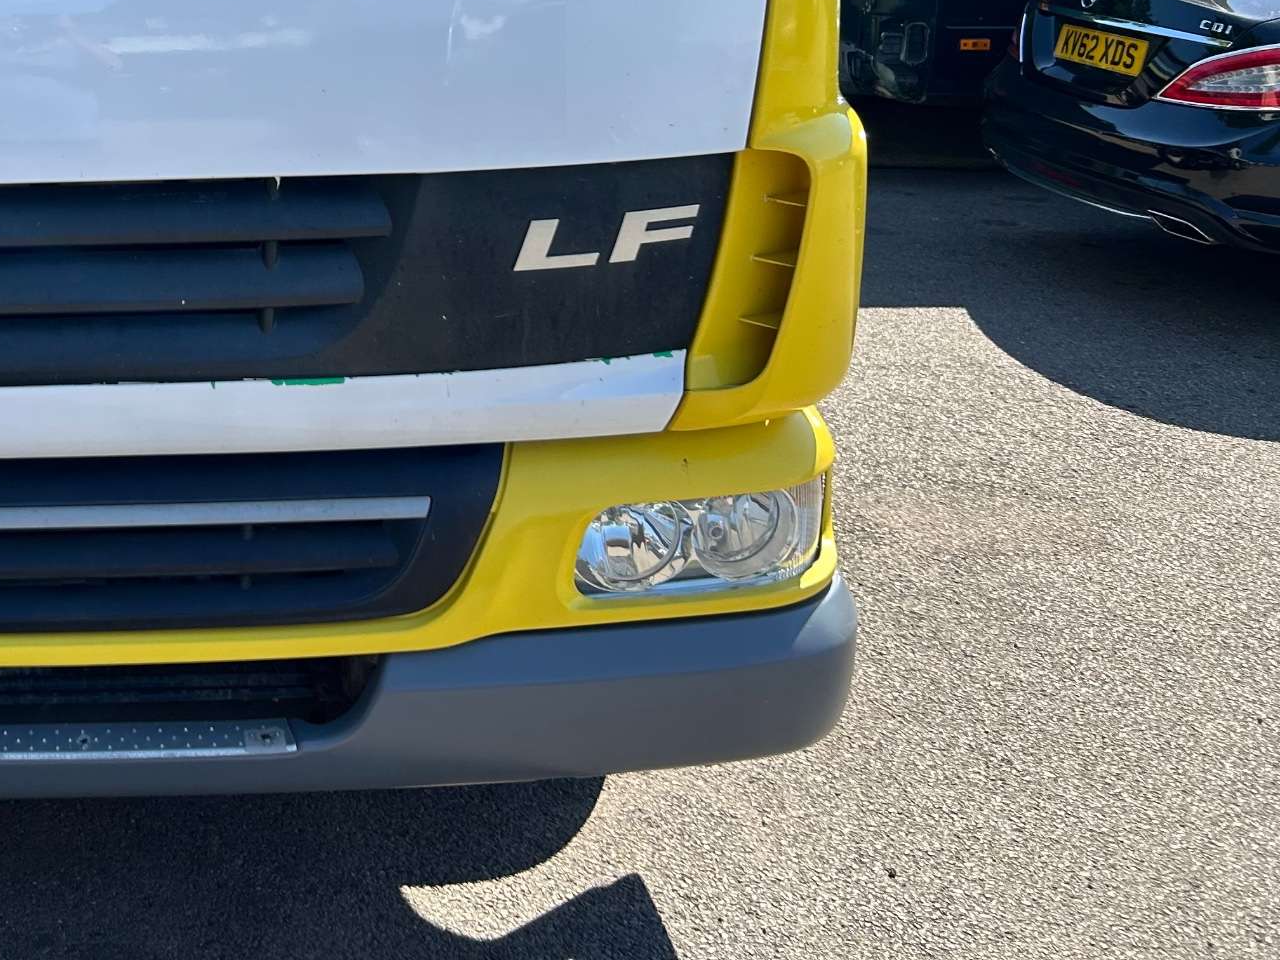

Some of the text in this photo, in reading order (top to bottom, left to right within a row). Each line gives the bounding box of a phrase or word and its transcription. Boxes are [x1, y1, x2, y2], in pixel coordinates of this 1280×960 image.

[1199, 18, 1233, 35] CDI
[1060, 29, 1139, 70] KV62 XDS
[513, 204, 701, 272] LF
